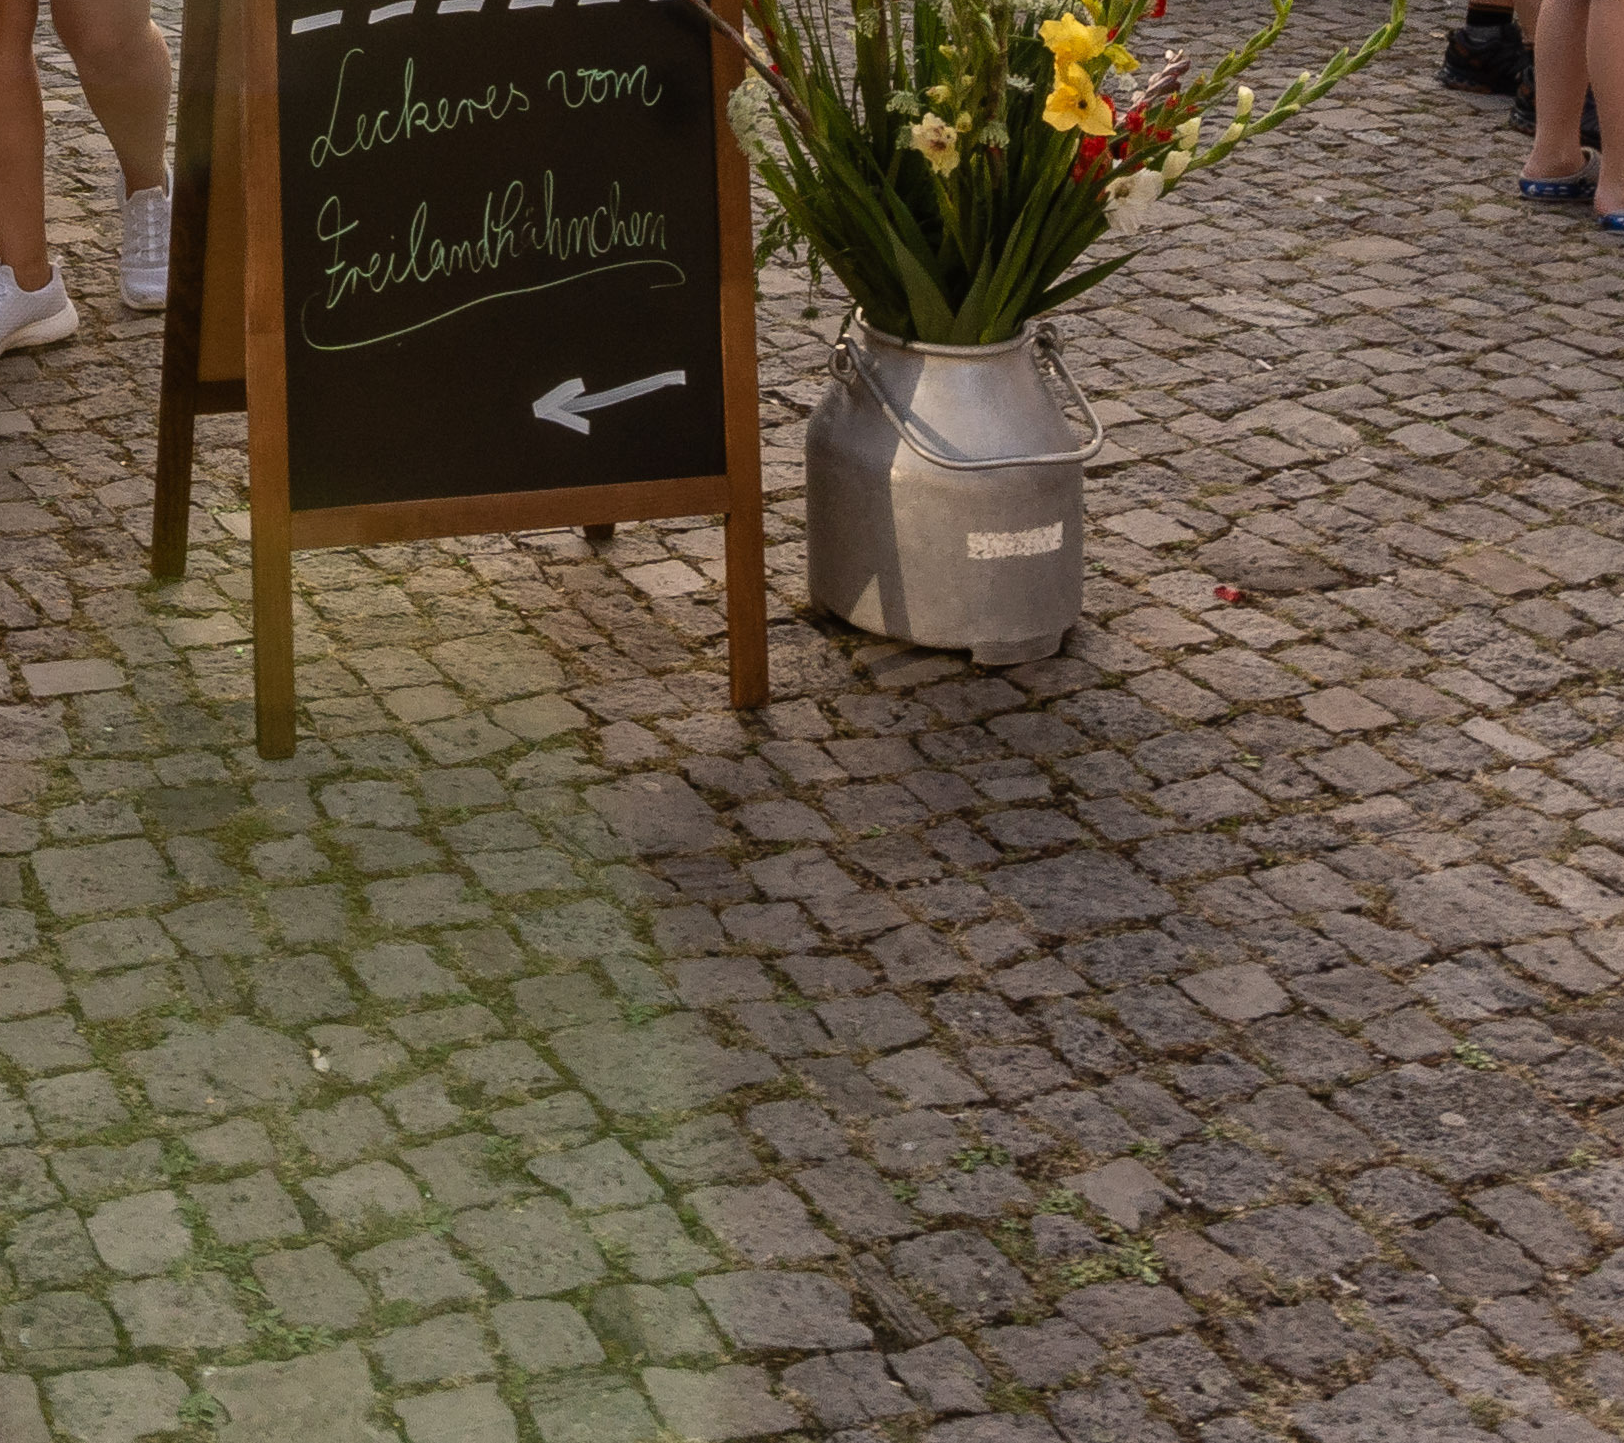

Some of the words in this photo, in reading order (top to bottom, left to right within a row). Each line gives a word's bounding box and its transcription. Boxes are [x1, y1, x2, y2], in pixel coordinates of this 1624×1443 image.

[310, 47, 531, 169] Leckeres
[548, 63, 663, 108] vom
[316, 168, 668, 312] Freilandhähnchen
